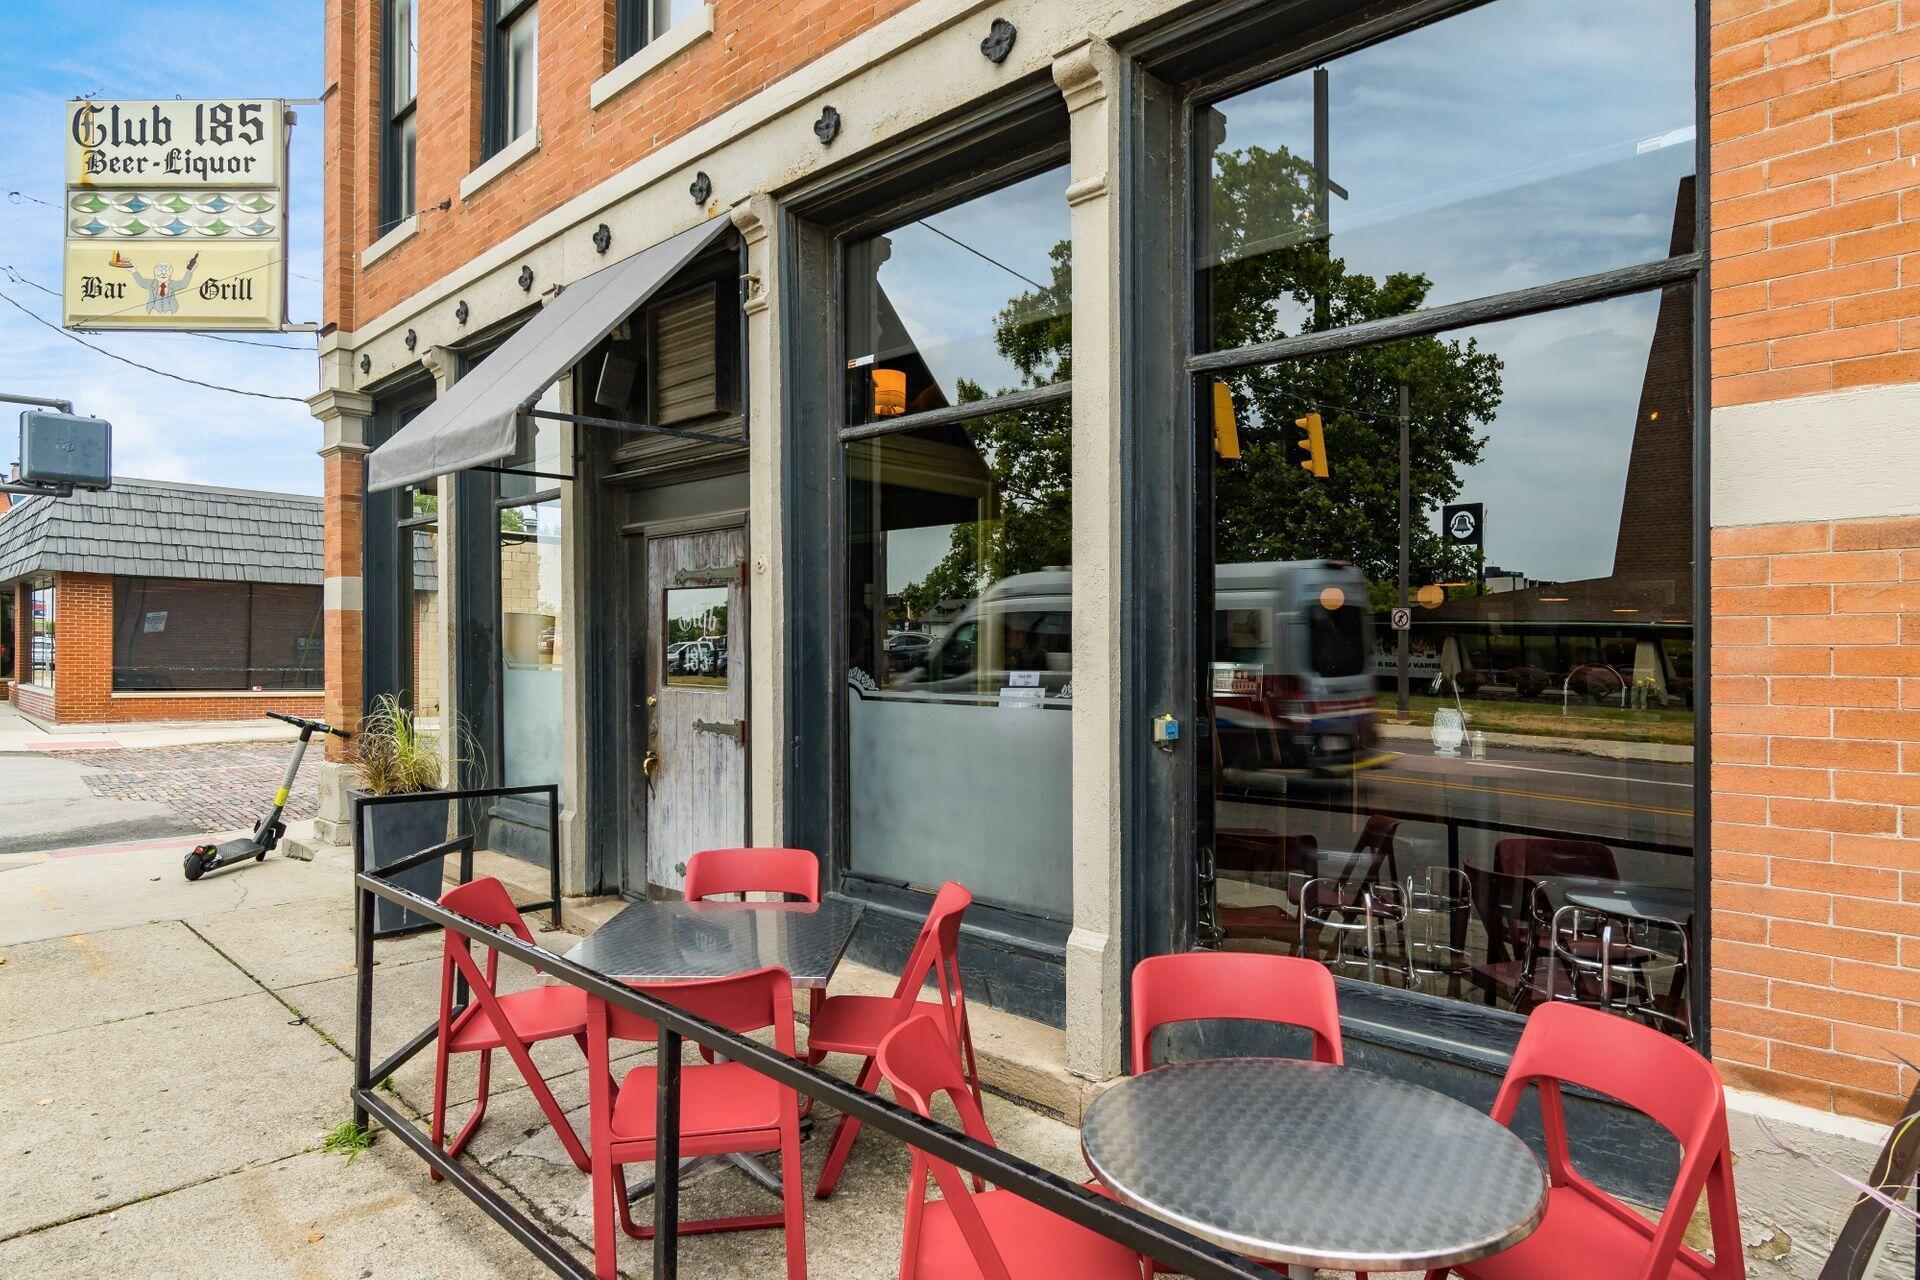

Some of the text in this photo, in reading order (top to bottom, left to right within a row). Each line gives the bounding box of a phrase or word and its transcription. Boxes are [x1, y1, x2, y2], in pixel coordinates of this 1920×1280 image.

[72, 103, 264, 148] Club 185
[81, 276, 127, 301] Bar
[199, 277, 253, 301] Grill
